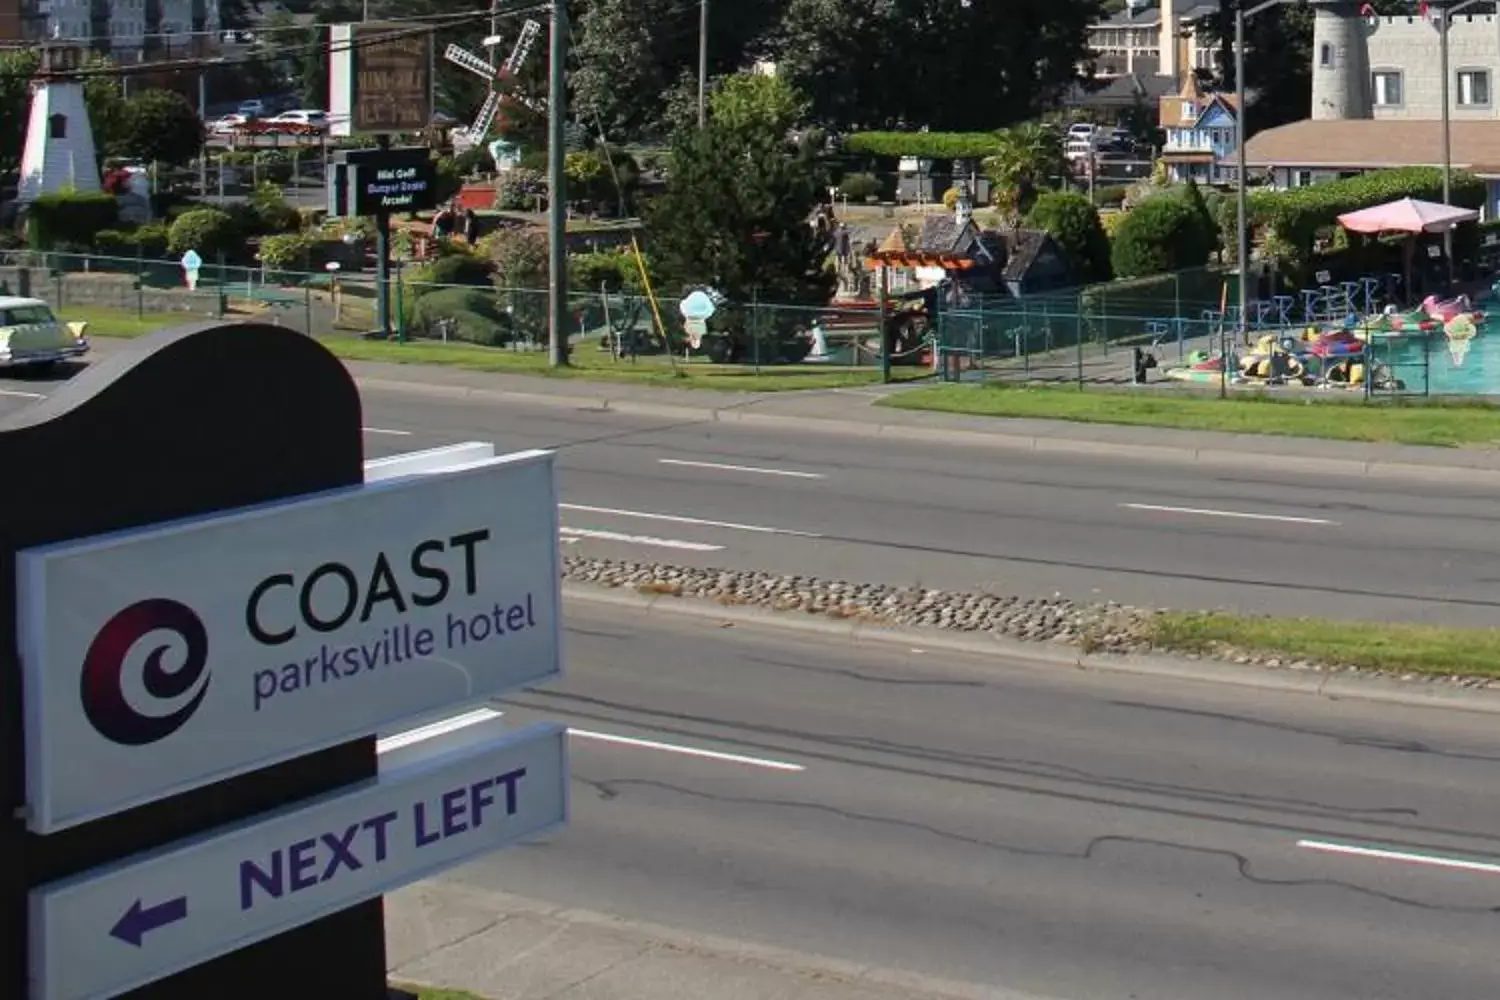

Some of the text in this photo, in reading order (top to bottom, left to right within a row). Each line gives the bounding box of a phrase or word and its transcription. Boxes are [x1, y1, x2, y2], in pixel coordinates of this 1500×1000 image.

[246, 529, 491, 645] COAST
[253, 594, 537, 711] parksville hotel
[239, 767, 526, 910] NEXT LEFT
